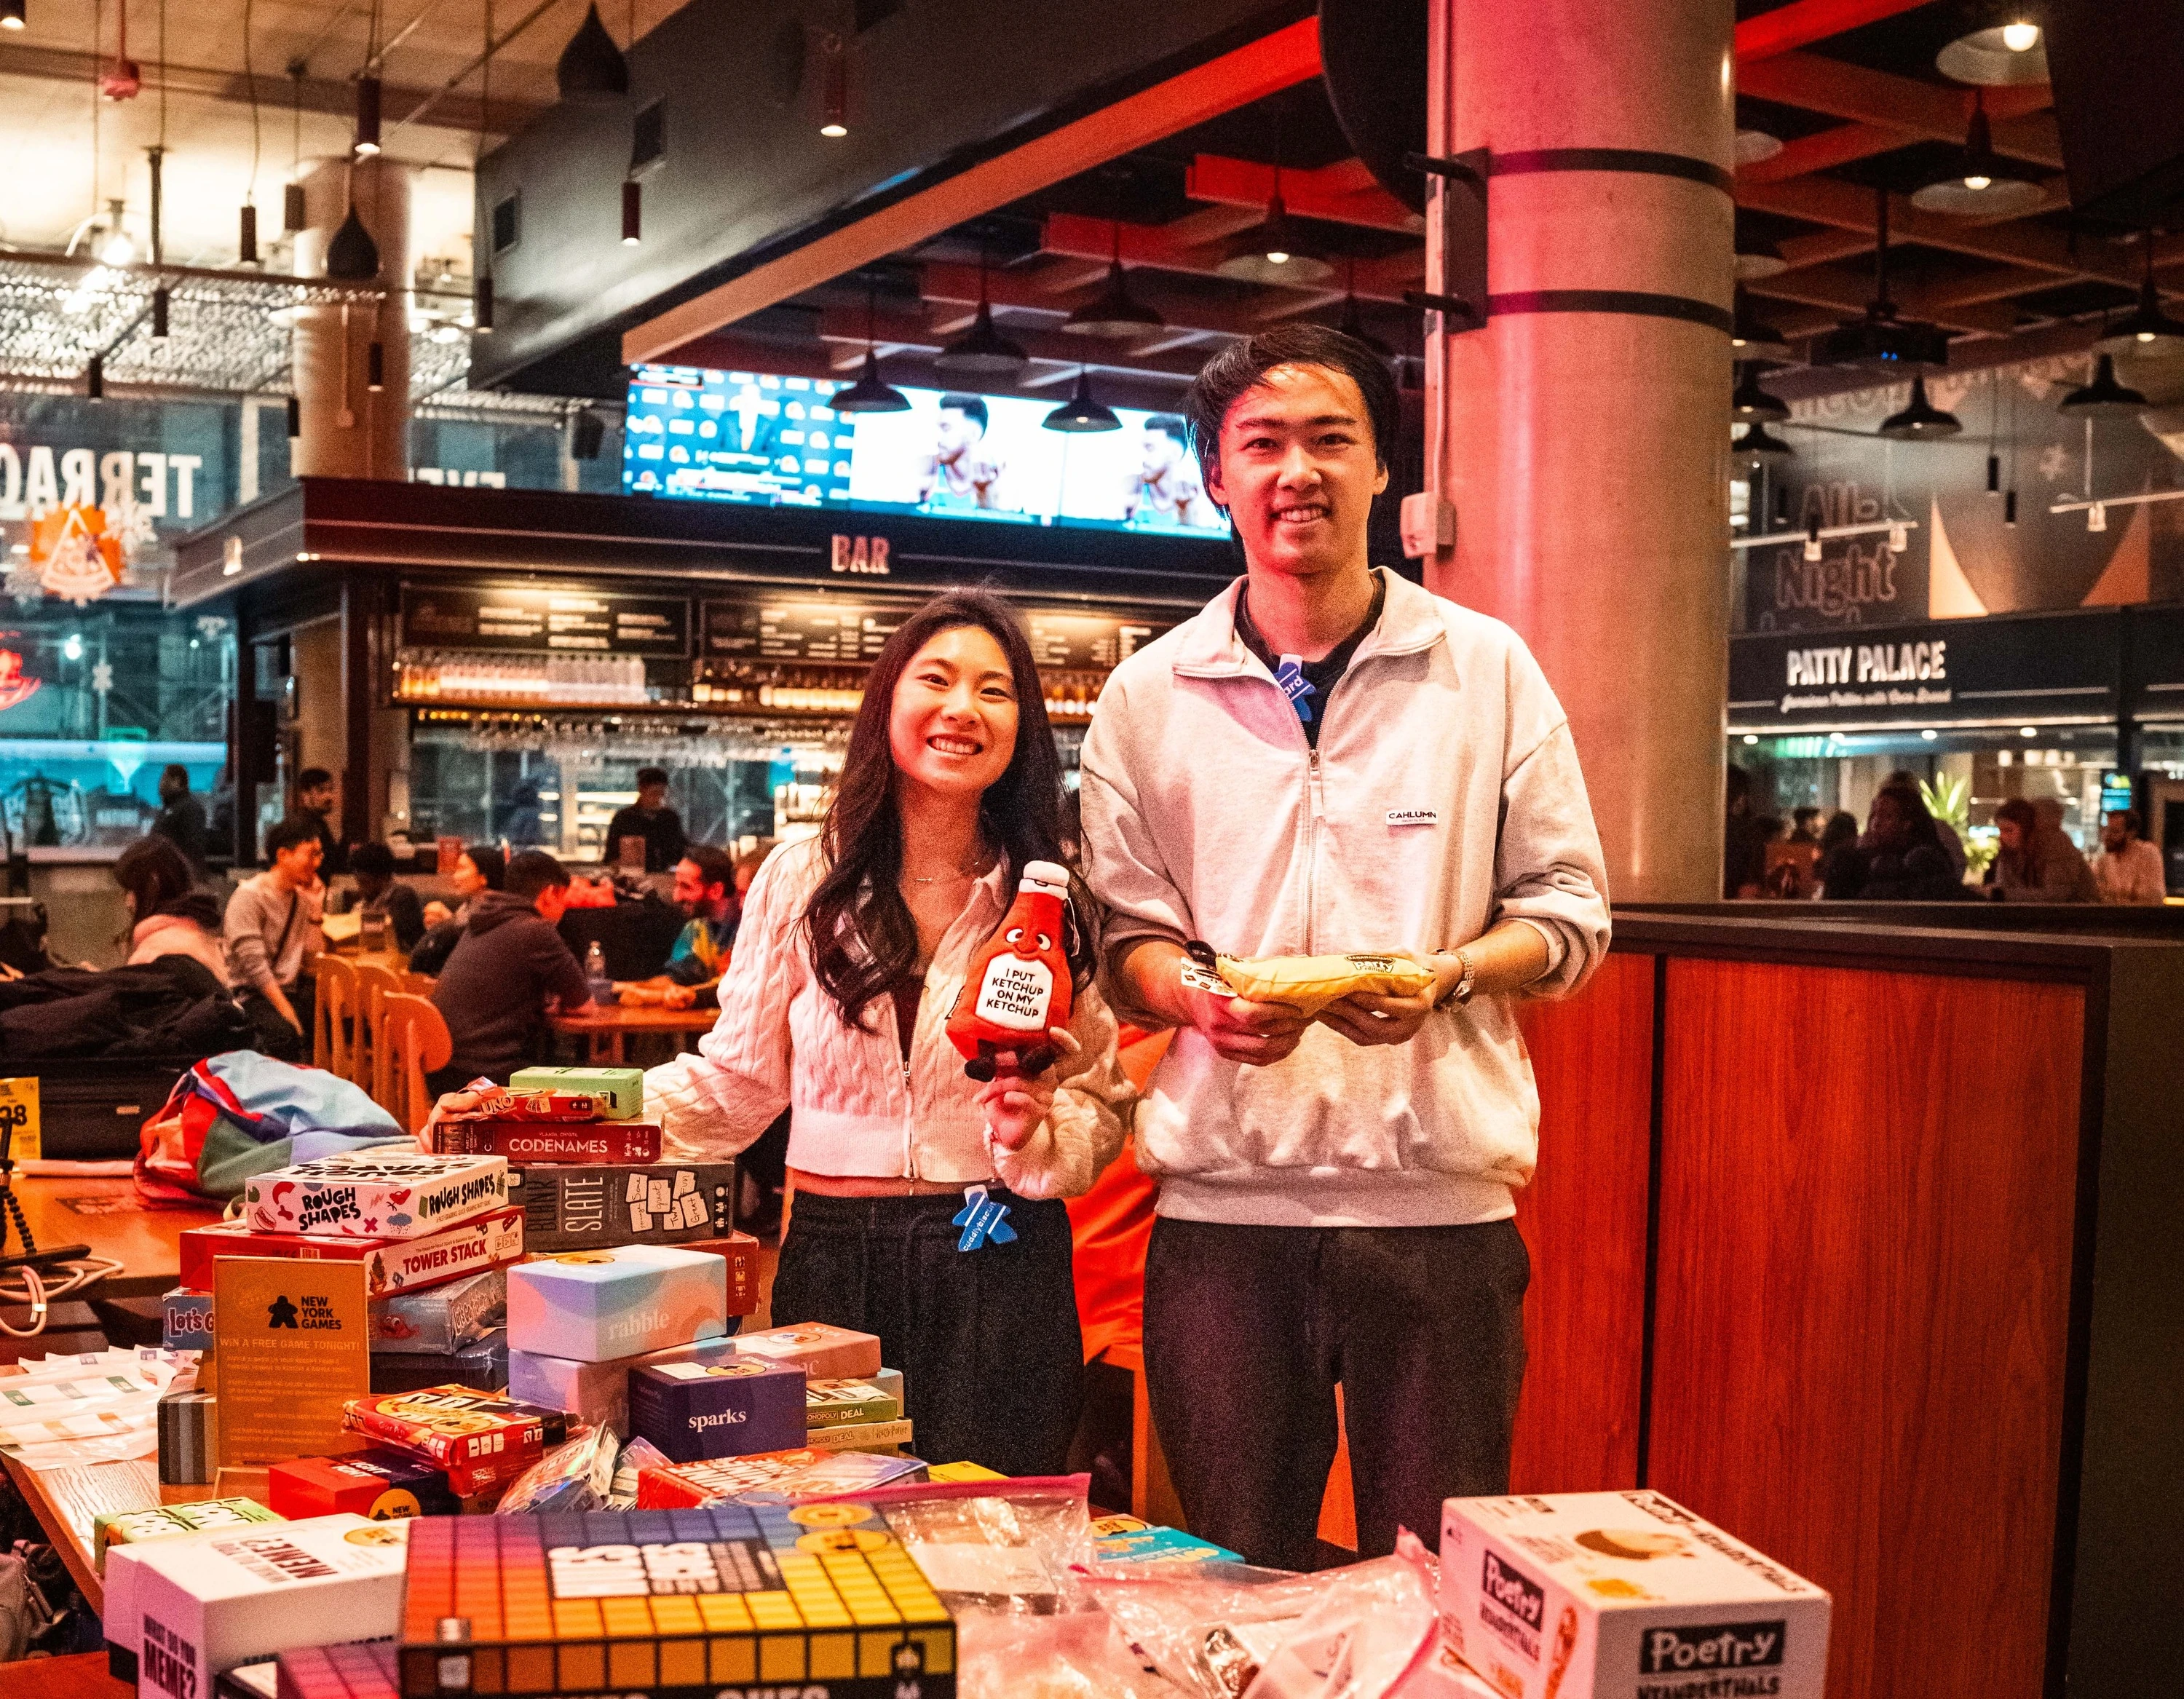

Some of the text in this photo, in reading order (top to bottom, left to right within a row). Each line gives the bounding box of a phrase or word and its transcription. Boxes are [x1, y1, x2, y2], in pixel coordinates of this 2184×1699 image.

[831, 534, 890, 574] BAR
[1776, 542, 1897, 617] Night
[1787, 641, 1946, 686] PATTY PALACE
[1283, 675, 1304, 695] ard
[1388, 811, 1436, 819] CAHLUMN
[1005, 968, 1035, 982] I PUT
[1353, 961, 1394, 973] party
[992, 978, 1043, 997] KETCHUP
[997, 990, 1034, 1005] ON MY
[986, 998, 1039, 1018] KETCHUP
[481, 1096, 515, 1114] UNO
[509, 1138, 608, 1154] CODENAMES
[301, 1187, 357, 1211] ROUGH
[429, 1173, 496, 1218] ROUGH SHAPES
[631, 1176, 641, 1200] Some
[655, 1180, 663, 1211] great
[526, 1180, 557, 1232] BLANK
[564, 1176, 604, 1232] SLATE
[298, 1203, 362, 1231] SHAPES
[962, 1200, 997, 1252] cuddlybiscuit
[403, 1238, 488, 1275] TOWER STACK
[301, 1295, 328, 1307] NEW
[301, 1307, 334, 1318] YORK
[168, 1307, 205, 1338] Let's
[301, 1318, 342, 1331] GAMES
[609, 1310, 670, 1341] rabble
[219, 1337, 360, 1351] WIN A FREE GAME TONIGHT!
[688, 1408, 747, 1433] sparks
[807, 1407, 865, 1420] ONOPOLY DEAL
[807, 1436, 831, 1445] NOPOLY
[832, 1431, 854, 1443] DEAL
[392, 1505, 411, 1514] NEW
[1487, 1553, 1541, 1624] Poetry
[1650, 1629, 1778, 1672] Poetry
[143, 1638, 197, 1698] MEME?
